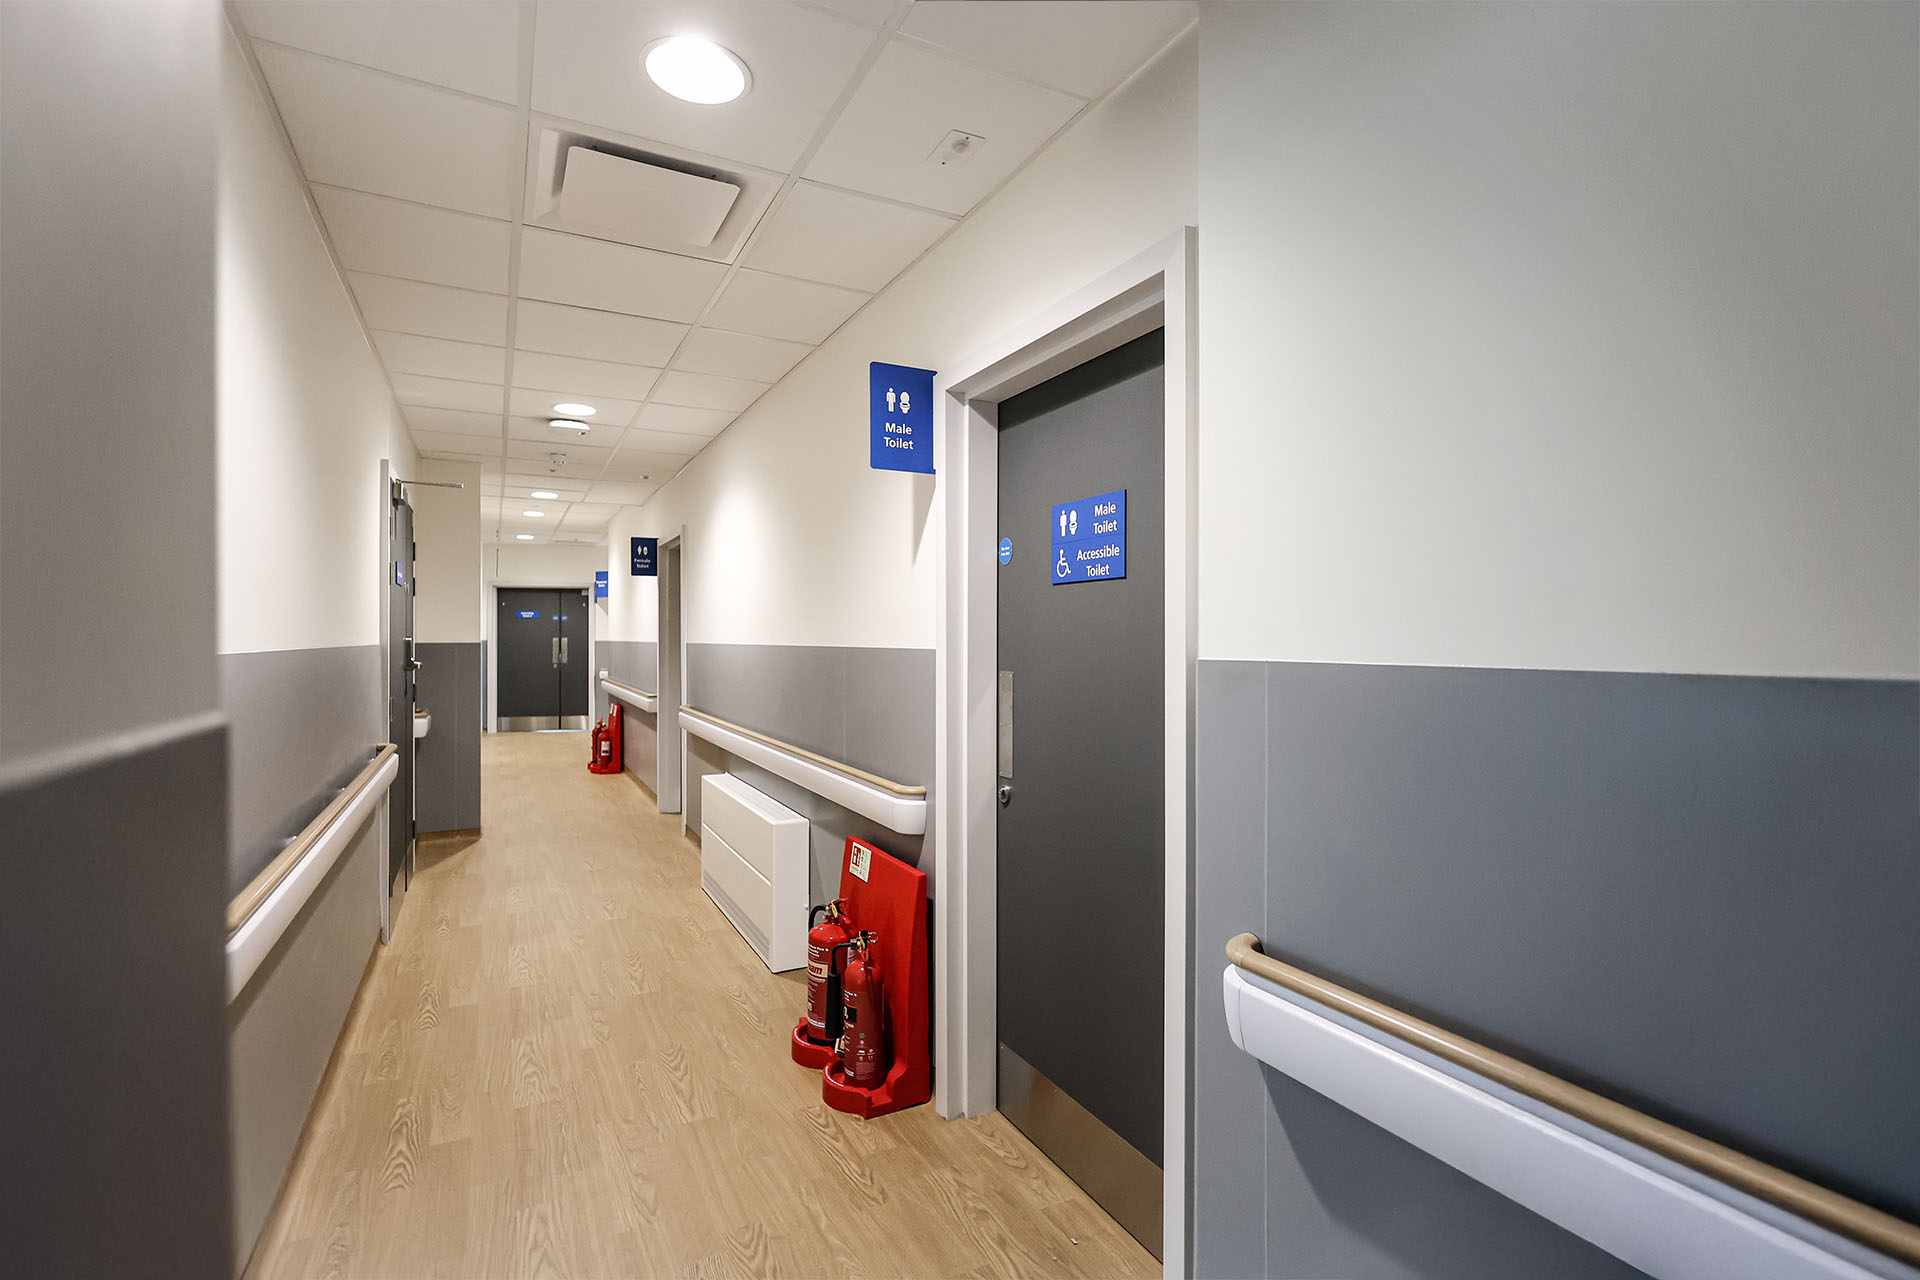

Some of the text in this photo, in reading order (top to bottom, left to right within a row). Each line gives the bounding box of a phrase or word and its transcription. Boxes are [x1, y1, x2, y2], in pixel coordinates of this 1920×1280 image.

[885, 422, 912, 434] Male
[884, 437, 914, 449] Toilet
[1094, 501, 1116, 517] Male
[1093, 520, 1118, 534] Toilet
[1077, 544, 1120, 561] Accessible
[1086, 564, 1110, 577] Toilet
